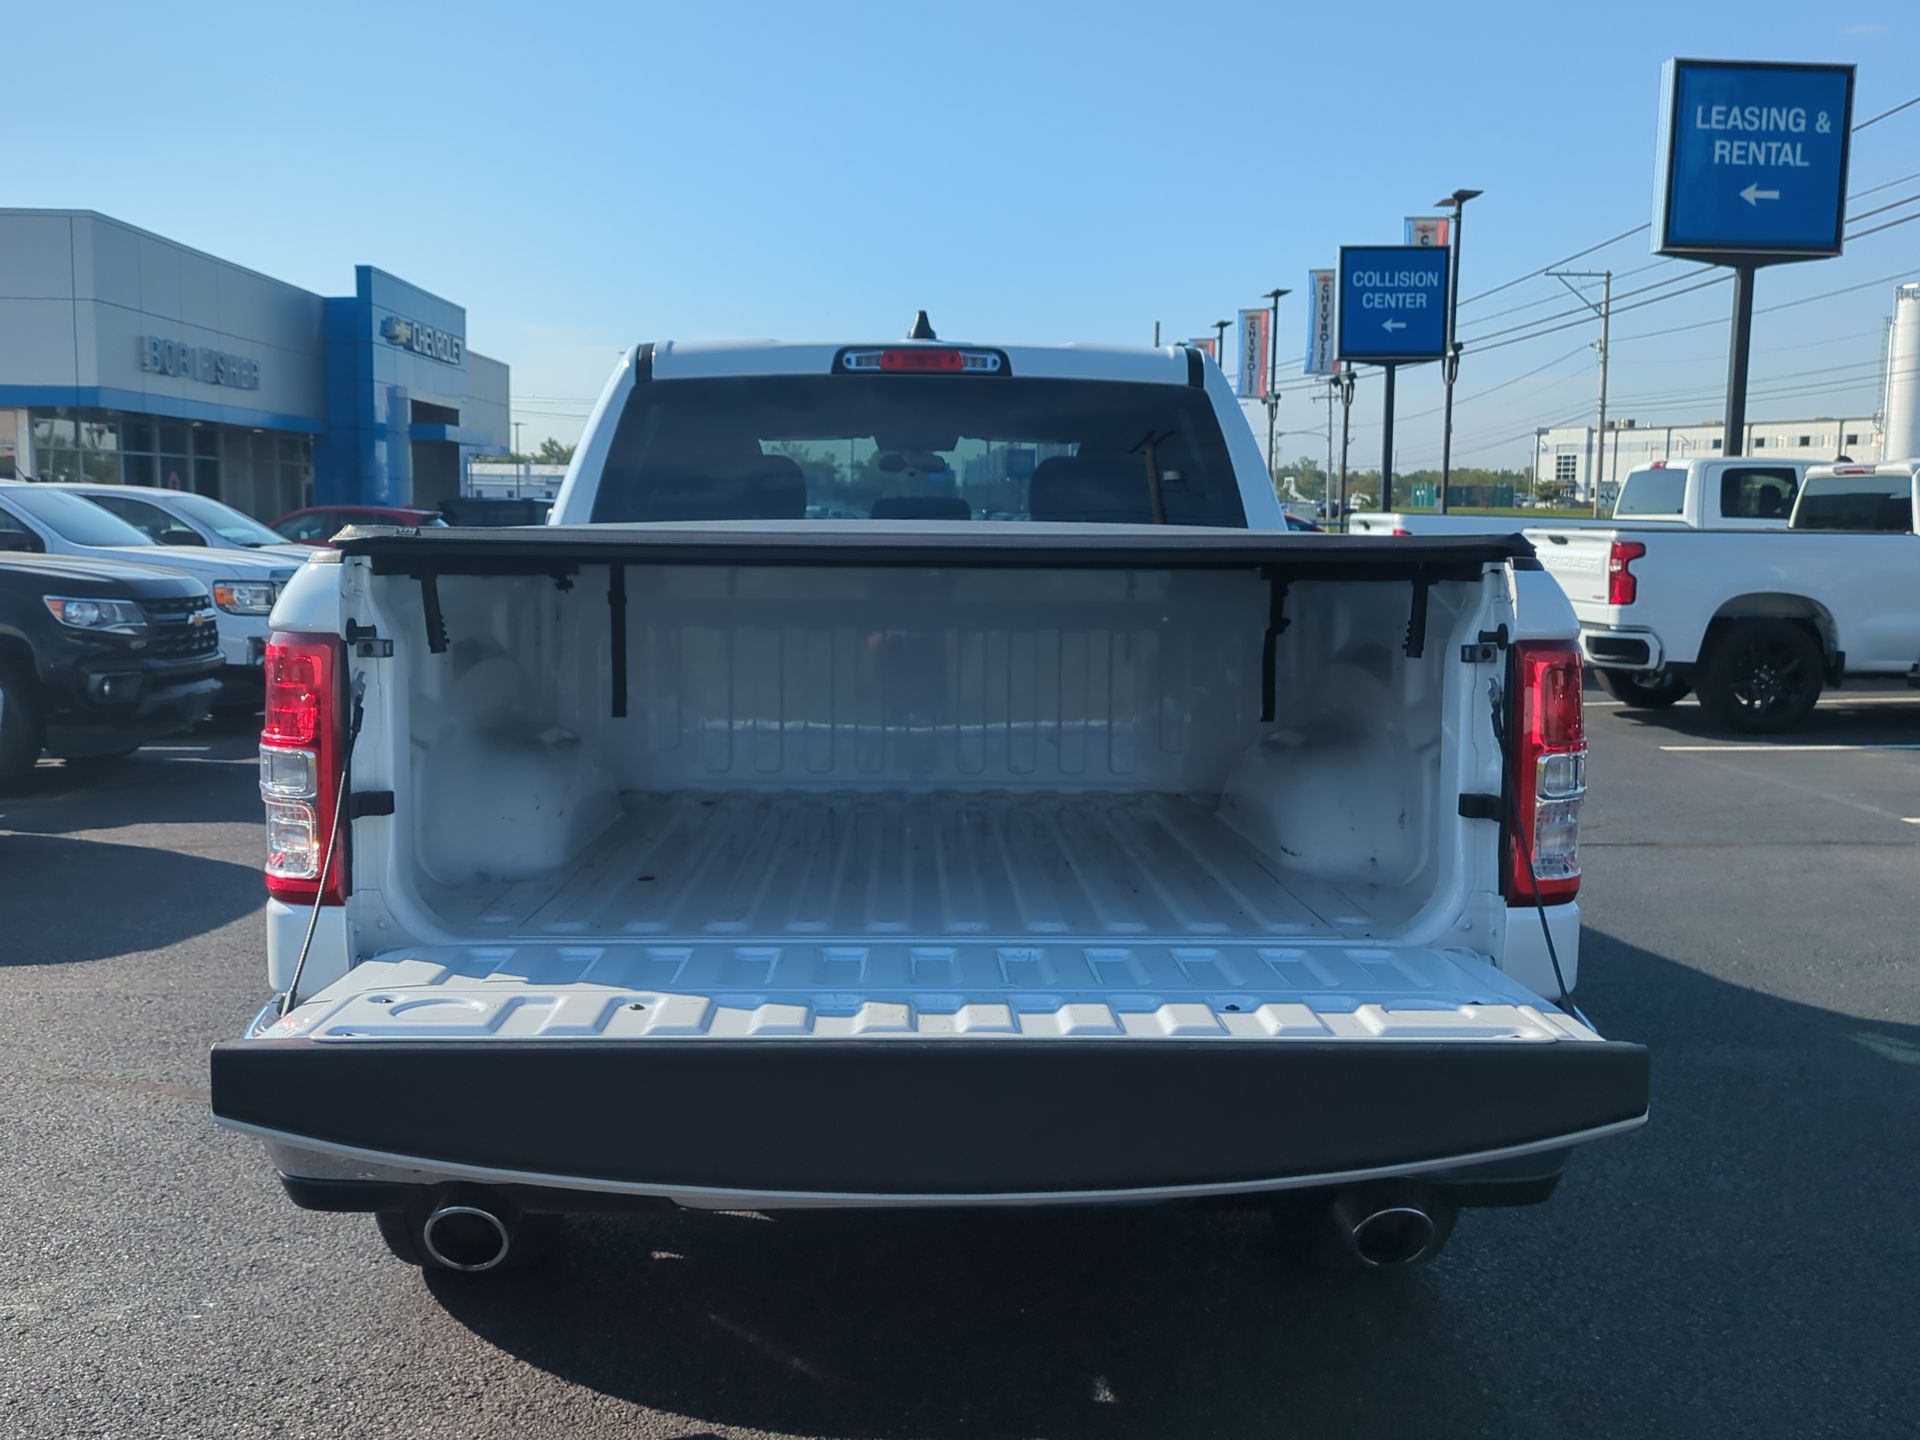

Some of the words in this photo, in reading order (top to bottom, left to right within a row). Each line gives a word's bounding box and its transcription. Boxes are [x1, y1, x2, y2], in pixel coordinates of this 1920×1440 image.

[1695, 105, 1807, 133] LEASING
[1815, 110, 1831, 134] &
[1712, 139, 1810, 167] RENTAL
[1352, 270, 1439, 288] COLLISION
[1362, 292, 1427, 309] CENTER
[1319, 284, 1330, 370] CHEVROLET
